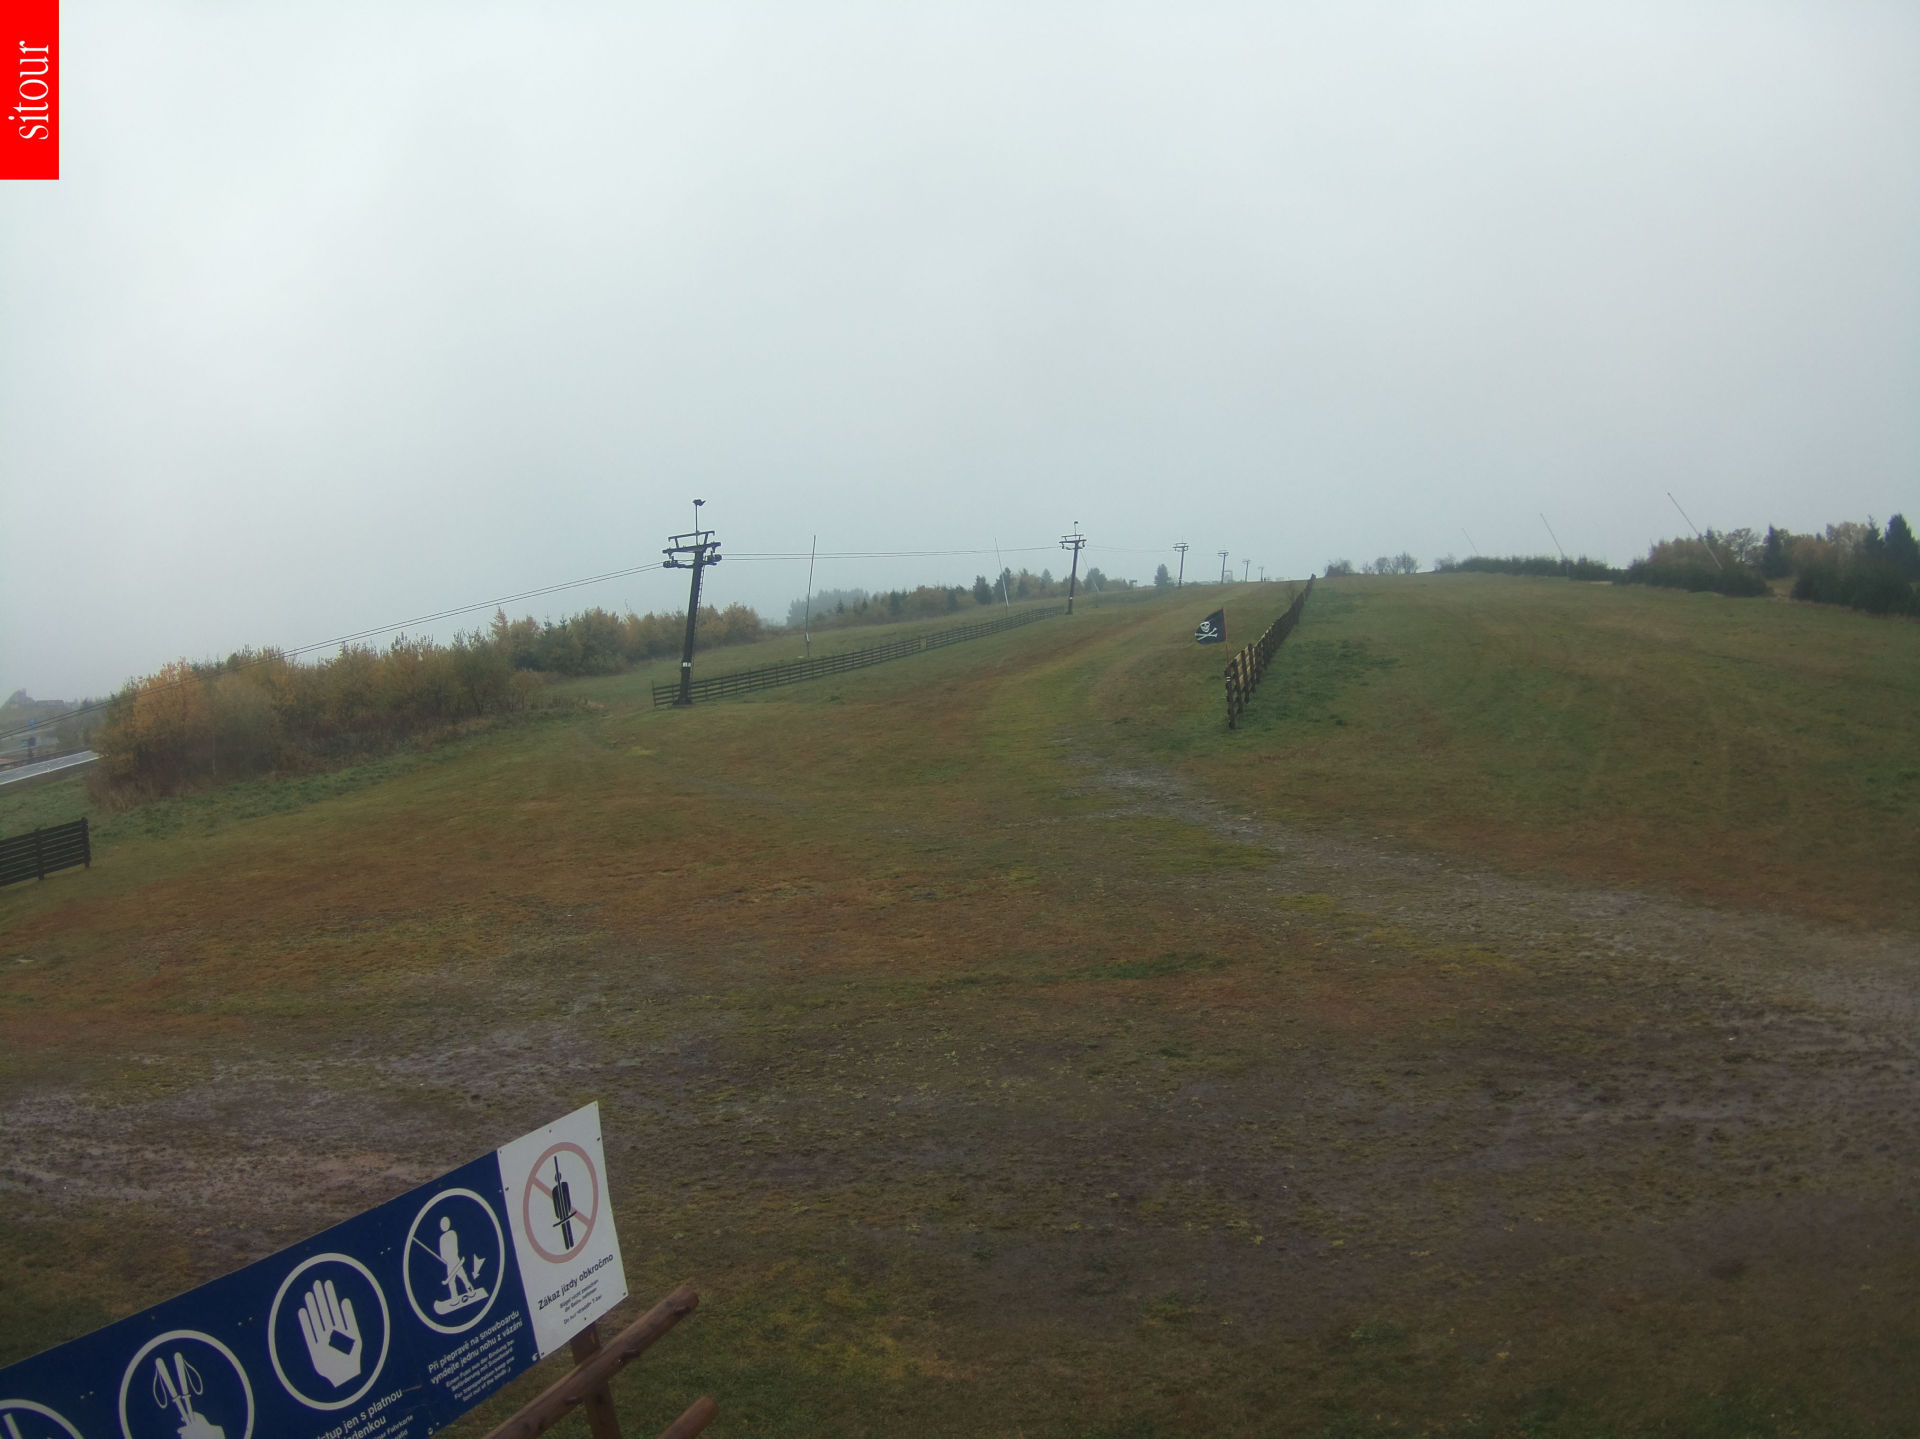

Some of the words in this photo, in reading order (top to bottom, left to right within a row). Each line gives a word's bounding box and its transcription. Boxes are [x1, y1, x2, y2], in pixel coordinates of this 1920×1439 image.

[538, 1291, 561, 1311] Zákaz
[562, 1279, 578, 1296] jízdy
[580, 1255, 614, 1282] obkročmo
[429, 1361, 439, 1374] Při
[440, 1341, 470, 1369] přepravě
[471, 1337, 480, 1347] na
[480, 1311, 520, 1340] snowboardu
[431, 1362, 460, 1385] vyndejte
[461, 1350, 480, 1367] jednu
[480, 1338, 497, 1352] nohu
[343, 1417, 359, 1434] jen
[361, 1412, 367, 1421] s
[368, 1389, 403, 1418] platnou
[344, 1417, 387, 1439] denkou
